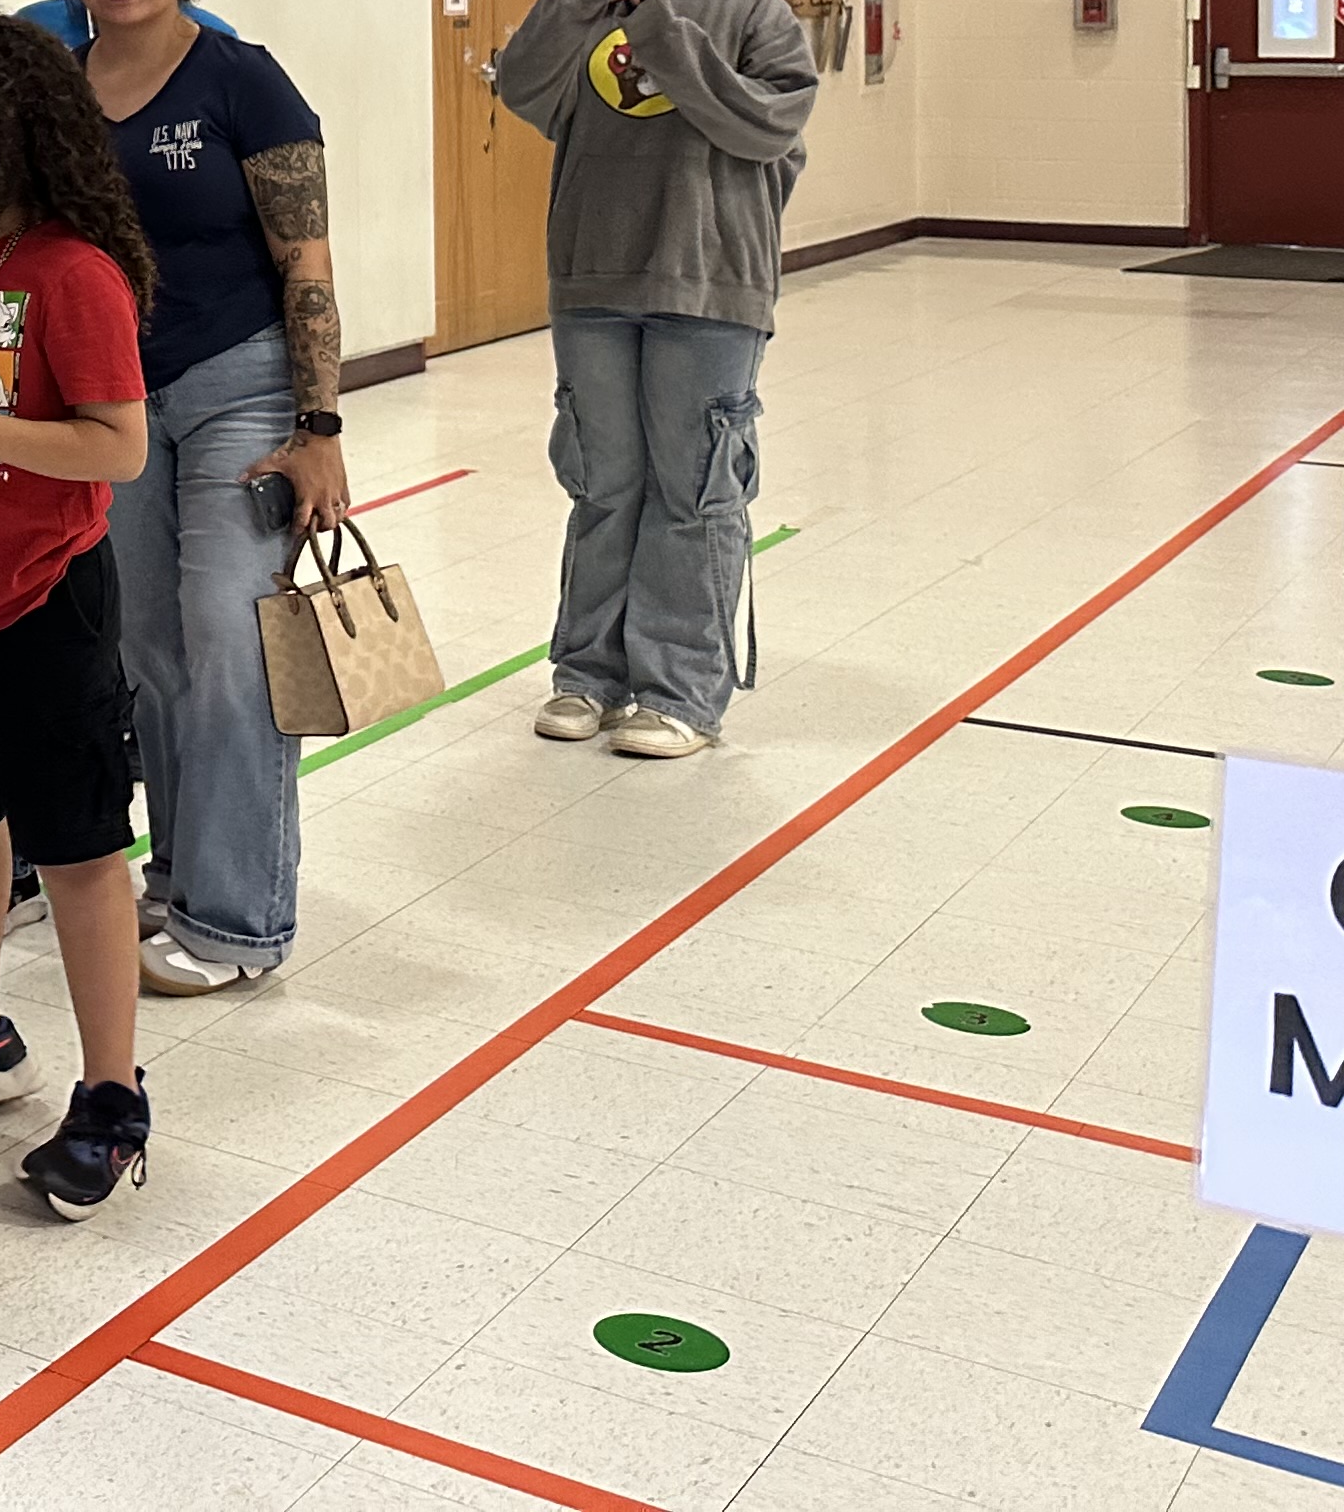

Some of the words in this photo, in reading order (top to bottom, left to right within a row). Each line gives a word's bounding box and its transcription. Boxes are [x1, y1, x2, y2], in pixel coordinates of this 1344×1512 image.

[174, 120, 202, 140] NAVY
[163, 149, 196, 171] 1775
[636, 1329, 683, 1357] 2
